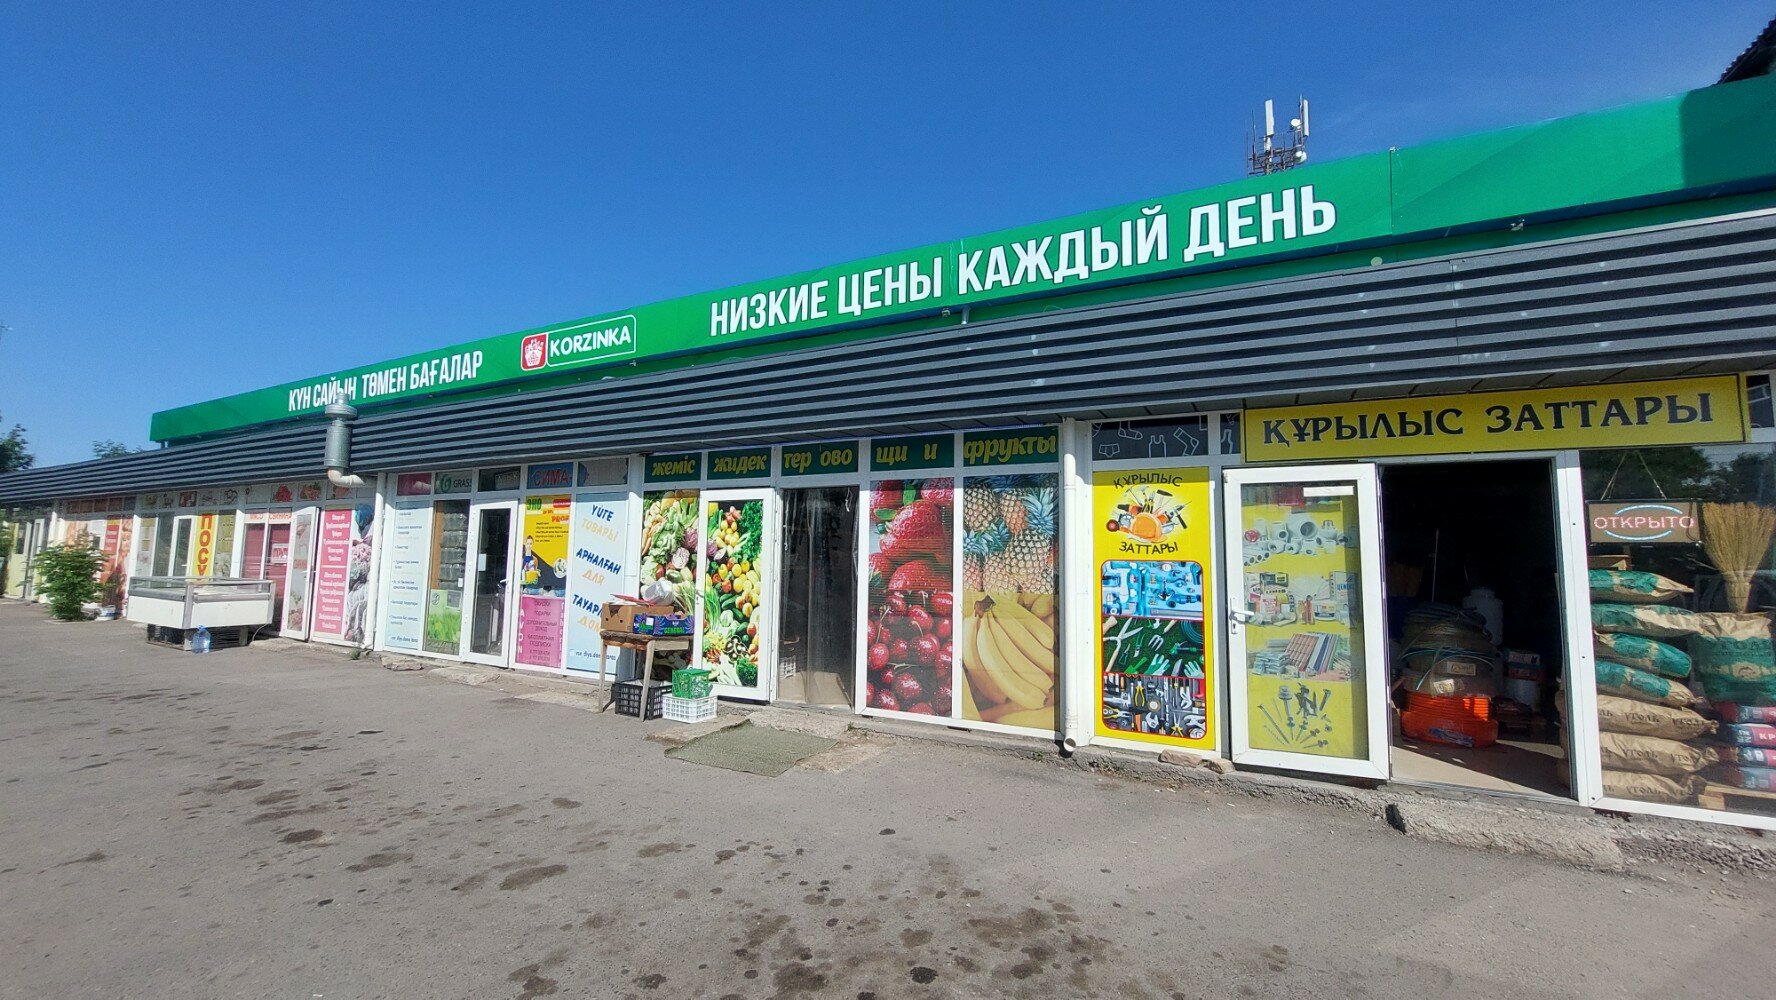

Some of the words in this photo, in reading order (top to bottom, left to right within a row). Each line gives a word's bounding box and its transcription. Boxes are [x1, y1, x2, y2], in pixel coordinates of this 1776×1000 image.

[709, 280, 829, 336] НИЗКИЕ
[837, 256, 943, 316] ЦЕНЫ
[958, 204, 1168, 295] КАЖДЫЙ
[1183, 184, 1337, 263] ДЕНЬ
[550, 325, 631, 357] KORZINKA
[313, 376, 356, 407] САЙЫН
[361, 366, 407, 399] ТӨМЕН
[409, 350, 483, 390] БАҒАЛАР
[1263, 408, 1464, 448] ҚҰРЫЛЫС
[1485, 392, 1714, 434] ЗАТТАРЫ
[651, 455, 695, 476] жеміс
[713, 454, 768, 475] жидек
[784, 451, 812, 473] тер
[820, 449, 853, 467] ово
[876, 445, 908, 466] щи
[923, 443, 938, 460] и
[963, 435, 1057, 465] фрукты
[582, 518, 618, 542] ТОВАРЫ
[1593, 516, 1695, 529] ОТКРЫТО
[1119, 541, 1178, 554] ЗАТТАРЫ
[576, 548, 622, 575] АРНАЛҒАН
[582, 569, 605, 586] ДЛЯ
[572, 594, 602, 617] ТАУАРЛ
